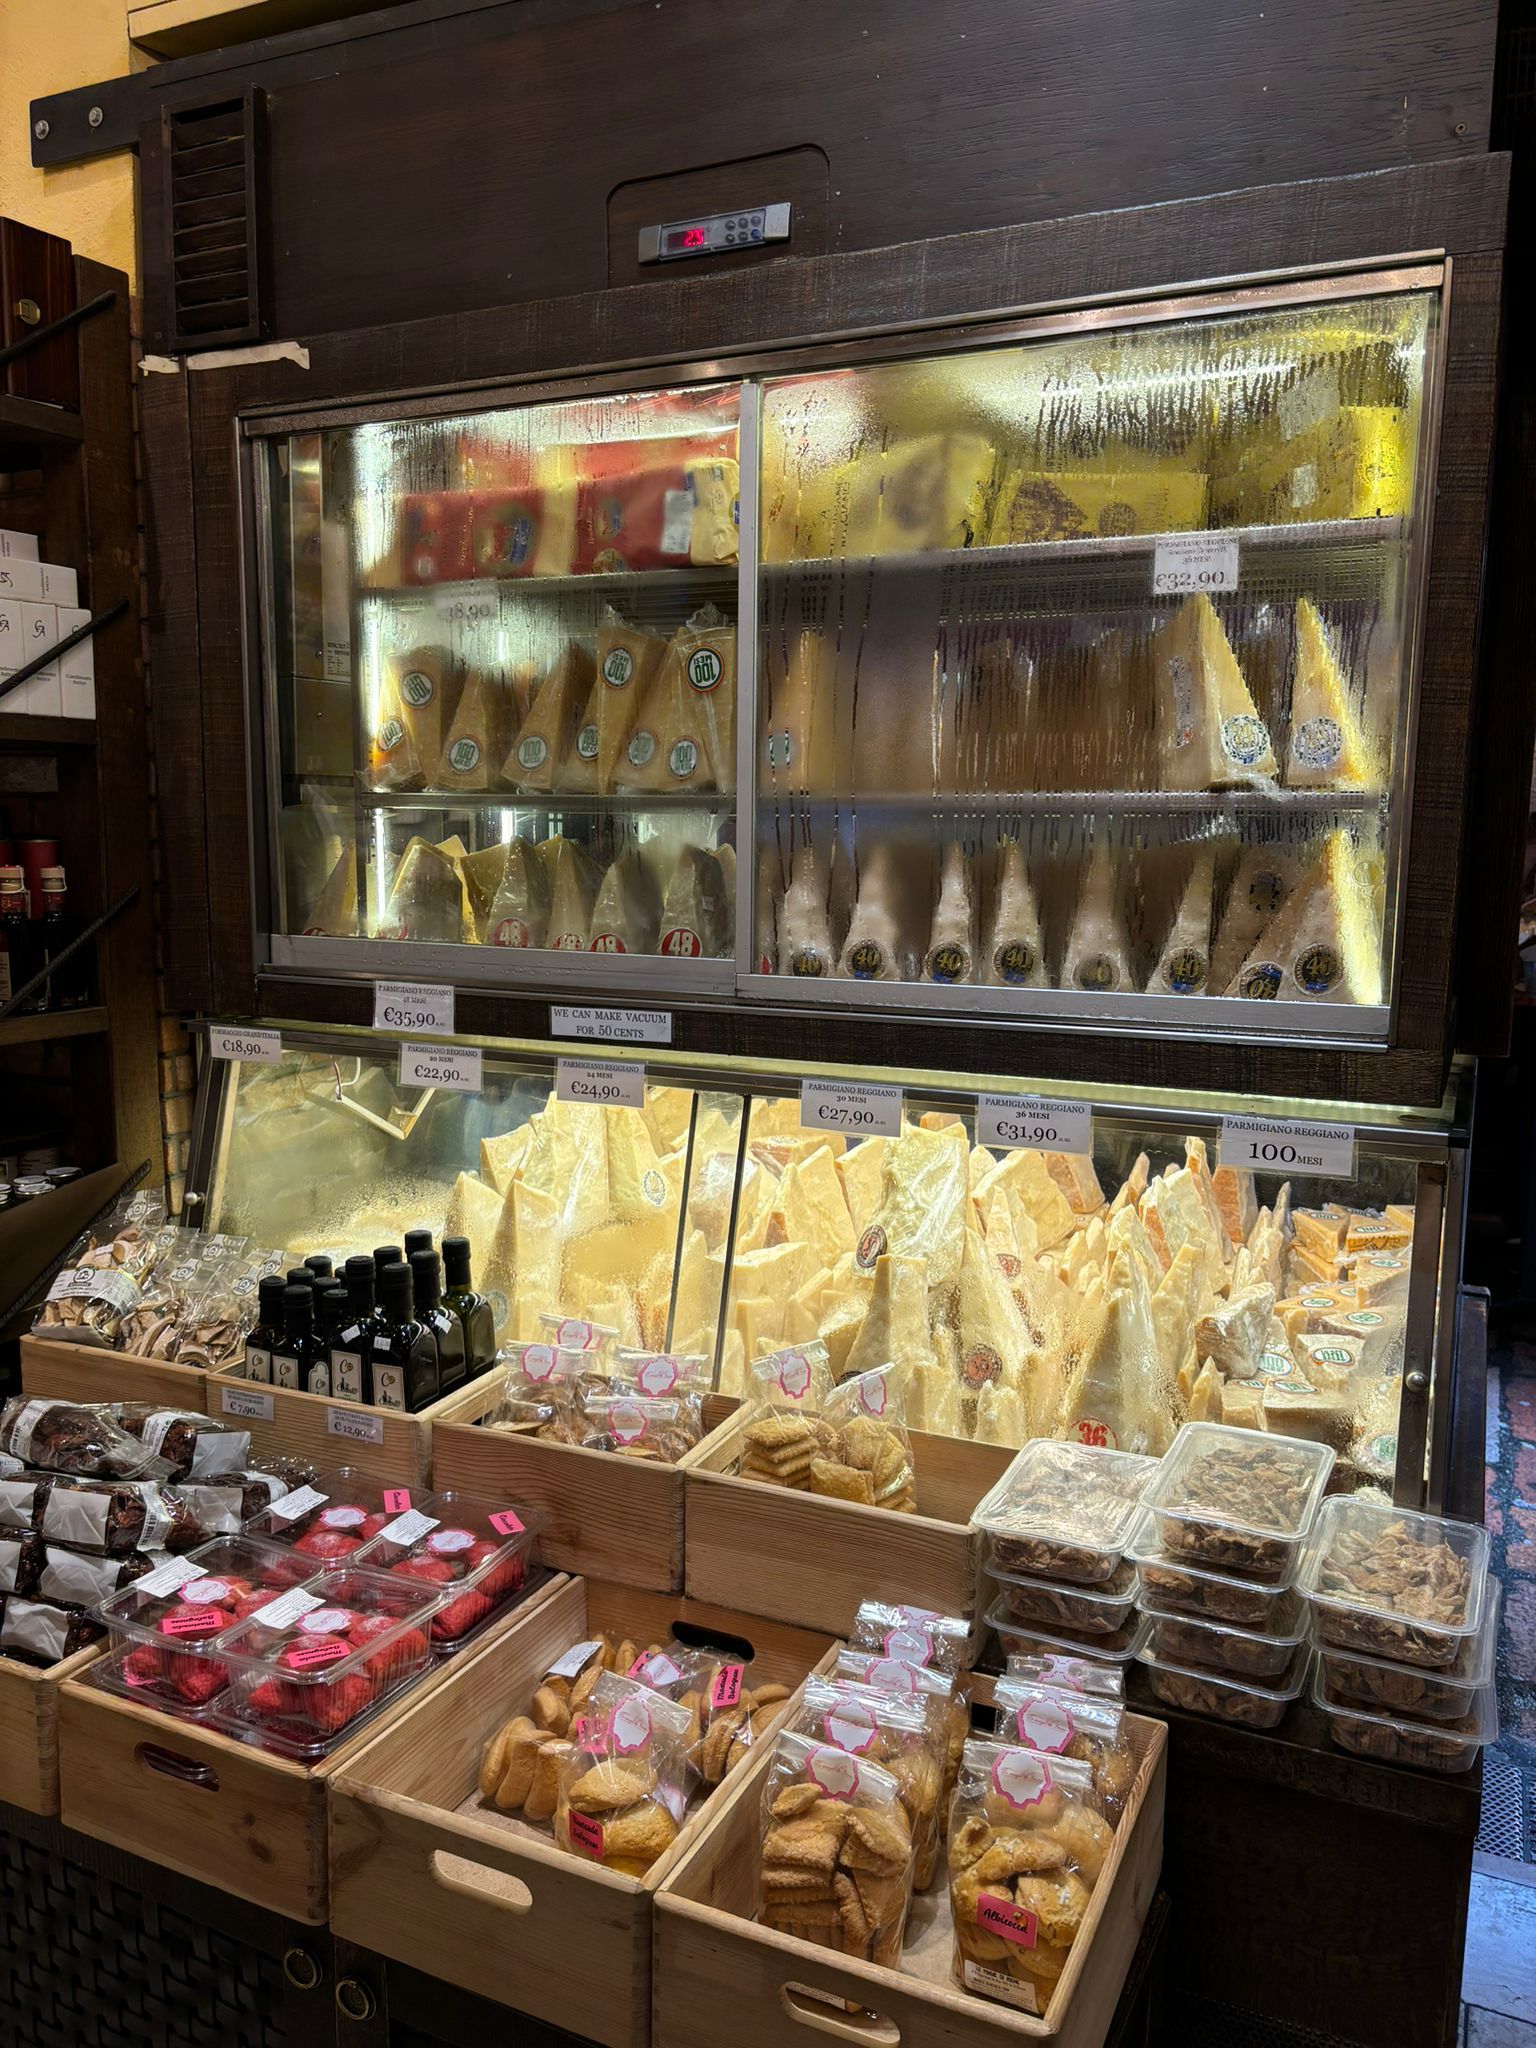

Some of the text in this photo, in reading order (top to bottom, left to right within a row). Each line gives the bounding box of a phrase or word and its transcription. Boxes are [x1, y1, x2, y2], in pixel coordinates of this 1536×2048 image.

[1156, 571, 1224, 590] €32,90
[693, 654, 713, 666] MESI
[608, 660, 630, 682] 100
[694, 664, 716, 684] 100
[407, 682, 431, 702] 100
[456, 741, 476, 762] 100
[524, 740, 542, 760] 100
[500, 920, 521, 947] 48
[668, 932, 694, 956] 48
[938, 952, 961, 971] 40
[378, 984, 418, 994] PARMIGIANO
[384, 1006, 435, 1028] €35,90
[554, 1008, 667, 1024] WE CAN MAKE VACUUM
[576, 1025, 644, 1038] FOR 50 CENTS
[222, 1040, 262, 1056] €18,90
[408, 1046, 478, 1057] PARMIGIANO REGGIANO
[414, 1064, 460, 1082] €22,90
[562, 1060, 640, 1073] PARMIGIANO REGGIANO
[571, 1080, 620, 1100] €24,90
[808, 1082, 897, 1098] PARMIGIANO REGGIANO
[818, 1104, 874, 1126] €27,90
[985, 1098, 1085, 1114] PARMIGIANO REGGIANO
[1028, 1112, 1050, 1120] MESI
[996, 1121, 1057, 1142] €31,90
[1226, 1120, 1350, 1140] PARMIGIANO REGGIANO
[1248, 1142, 1323, 1166] 100 MESI
[1262, 1356, 1284, 1369] 100
[230, 1400, 256, 1415] € 7,90
[334, 1422, 366, 1438] € 12,90
[1078, 1422, 1107, 1447] 36
[984, 1908, 1028, 1934] Albicocca
